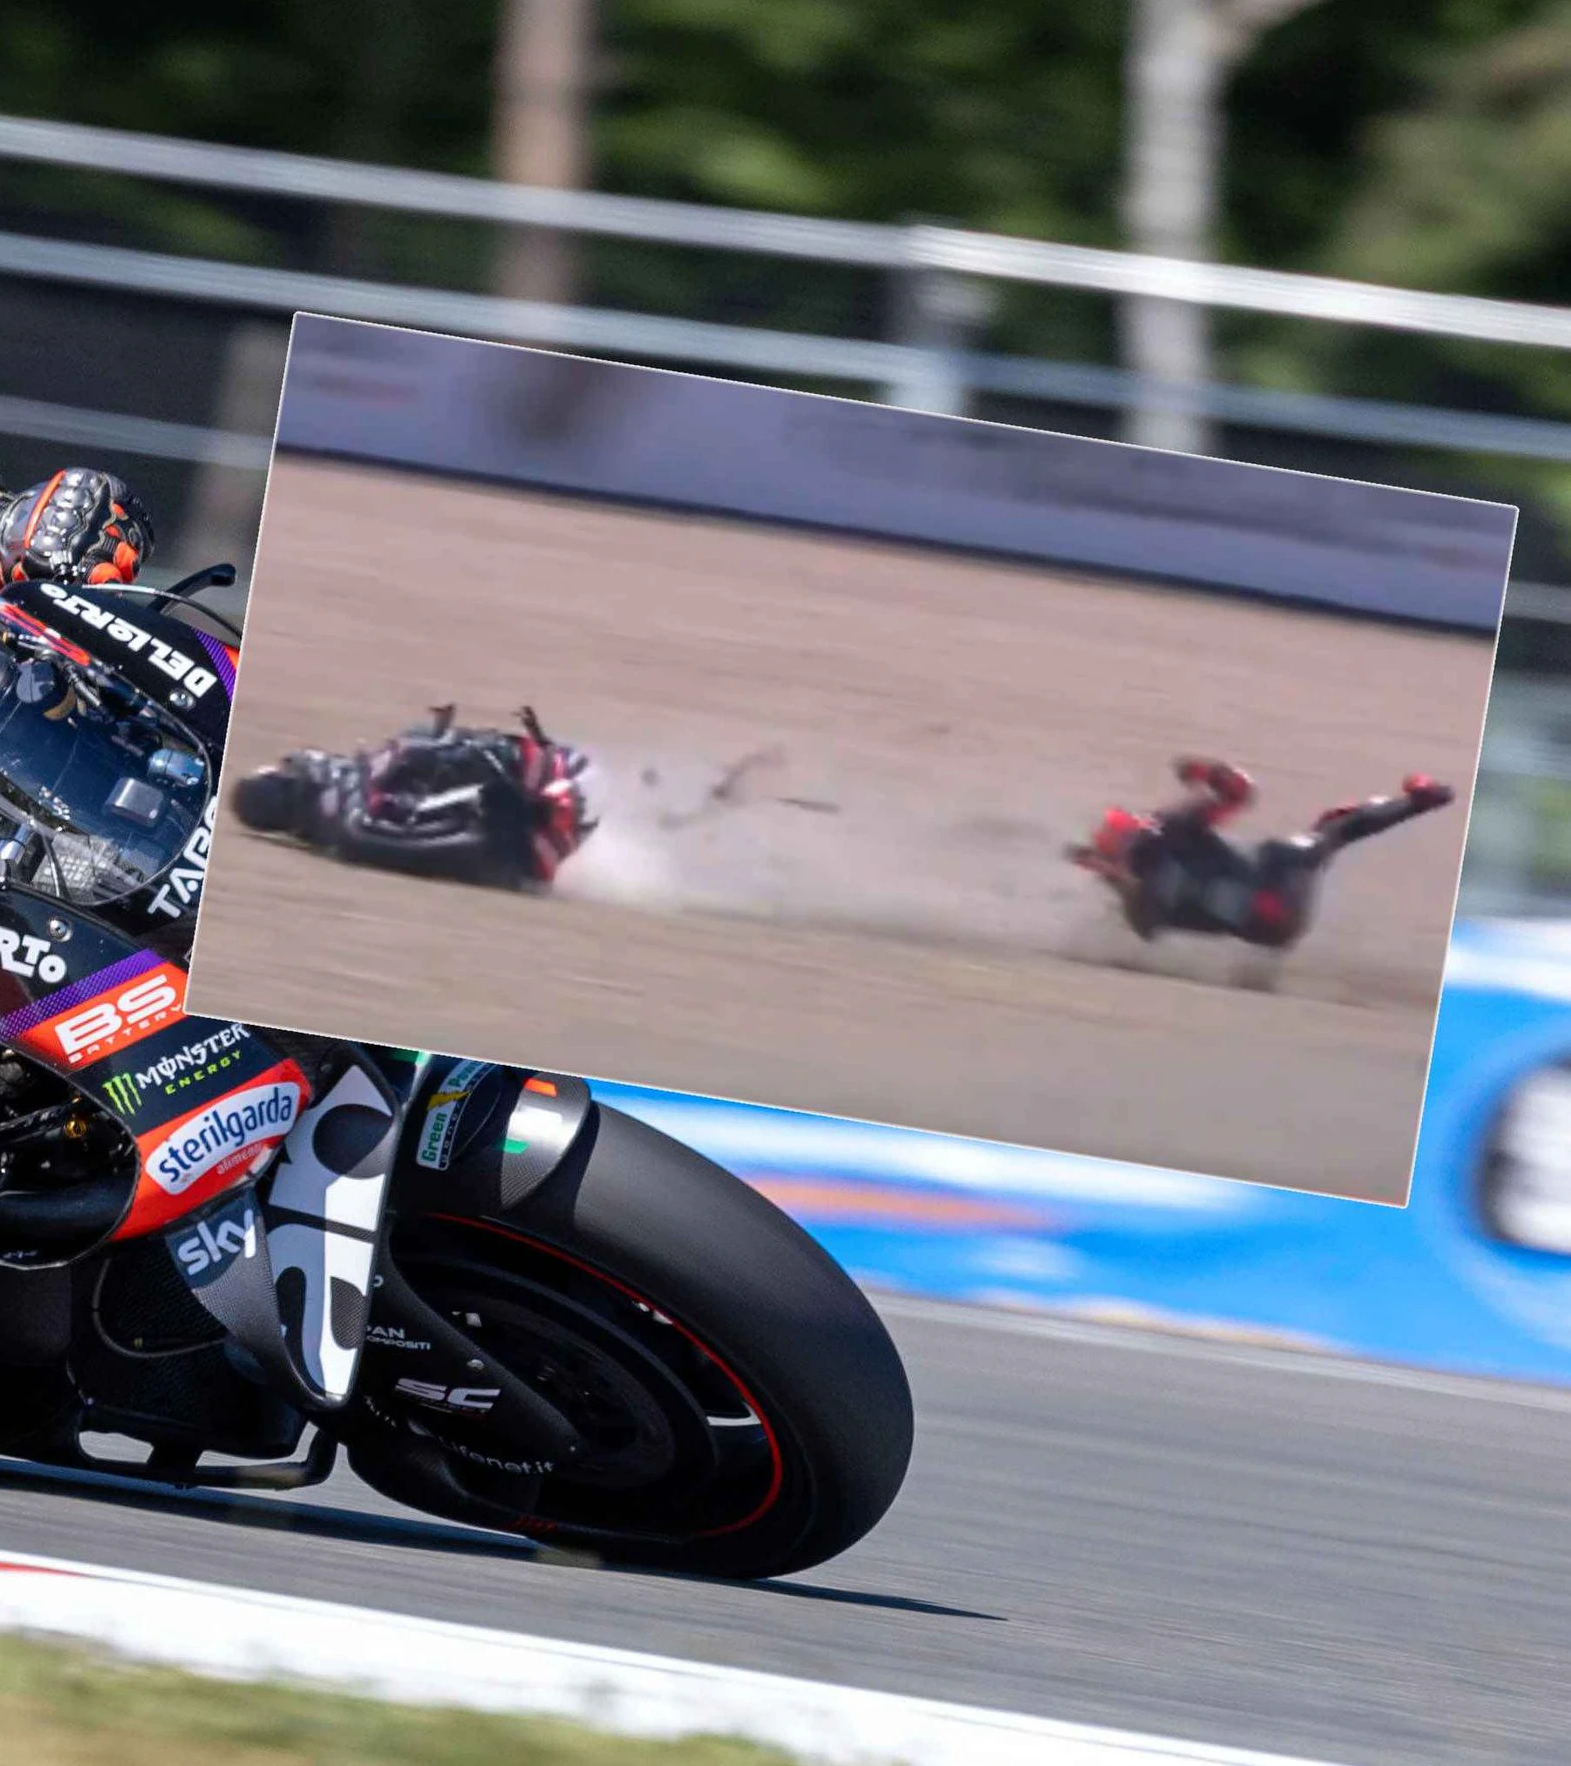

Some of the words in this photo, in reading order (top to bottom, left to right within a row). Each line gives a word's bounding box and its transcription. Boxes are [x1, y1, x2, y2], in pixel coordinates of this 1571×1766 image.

[39, 583, 218, 699] DELLORTO
[54, 974, 176, 1055] BS
[68, 1002, 182, 1064] BATTERY
[134, 1021, 252, 1090] MONSTER
[164, 1050, 242, 1096] ENERGY
[159, 1086, 293, 1183] sterilgarda
[421, 1112, 448, 1162] Green
[177, 1209, 257, 1276] sky
[366, 1325, 406, 1340] AN
[366, 1335, 432, 1351] OMPOSITI
[395, 1377, 502, 1409] SC
